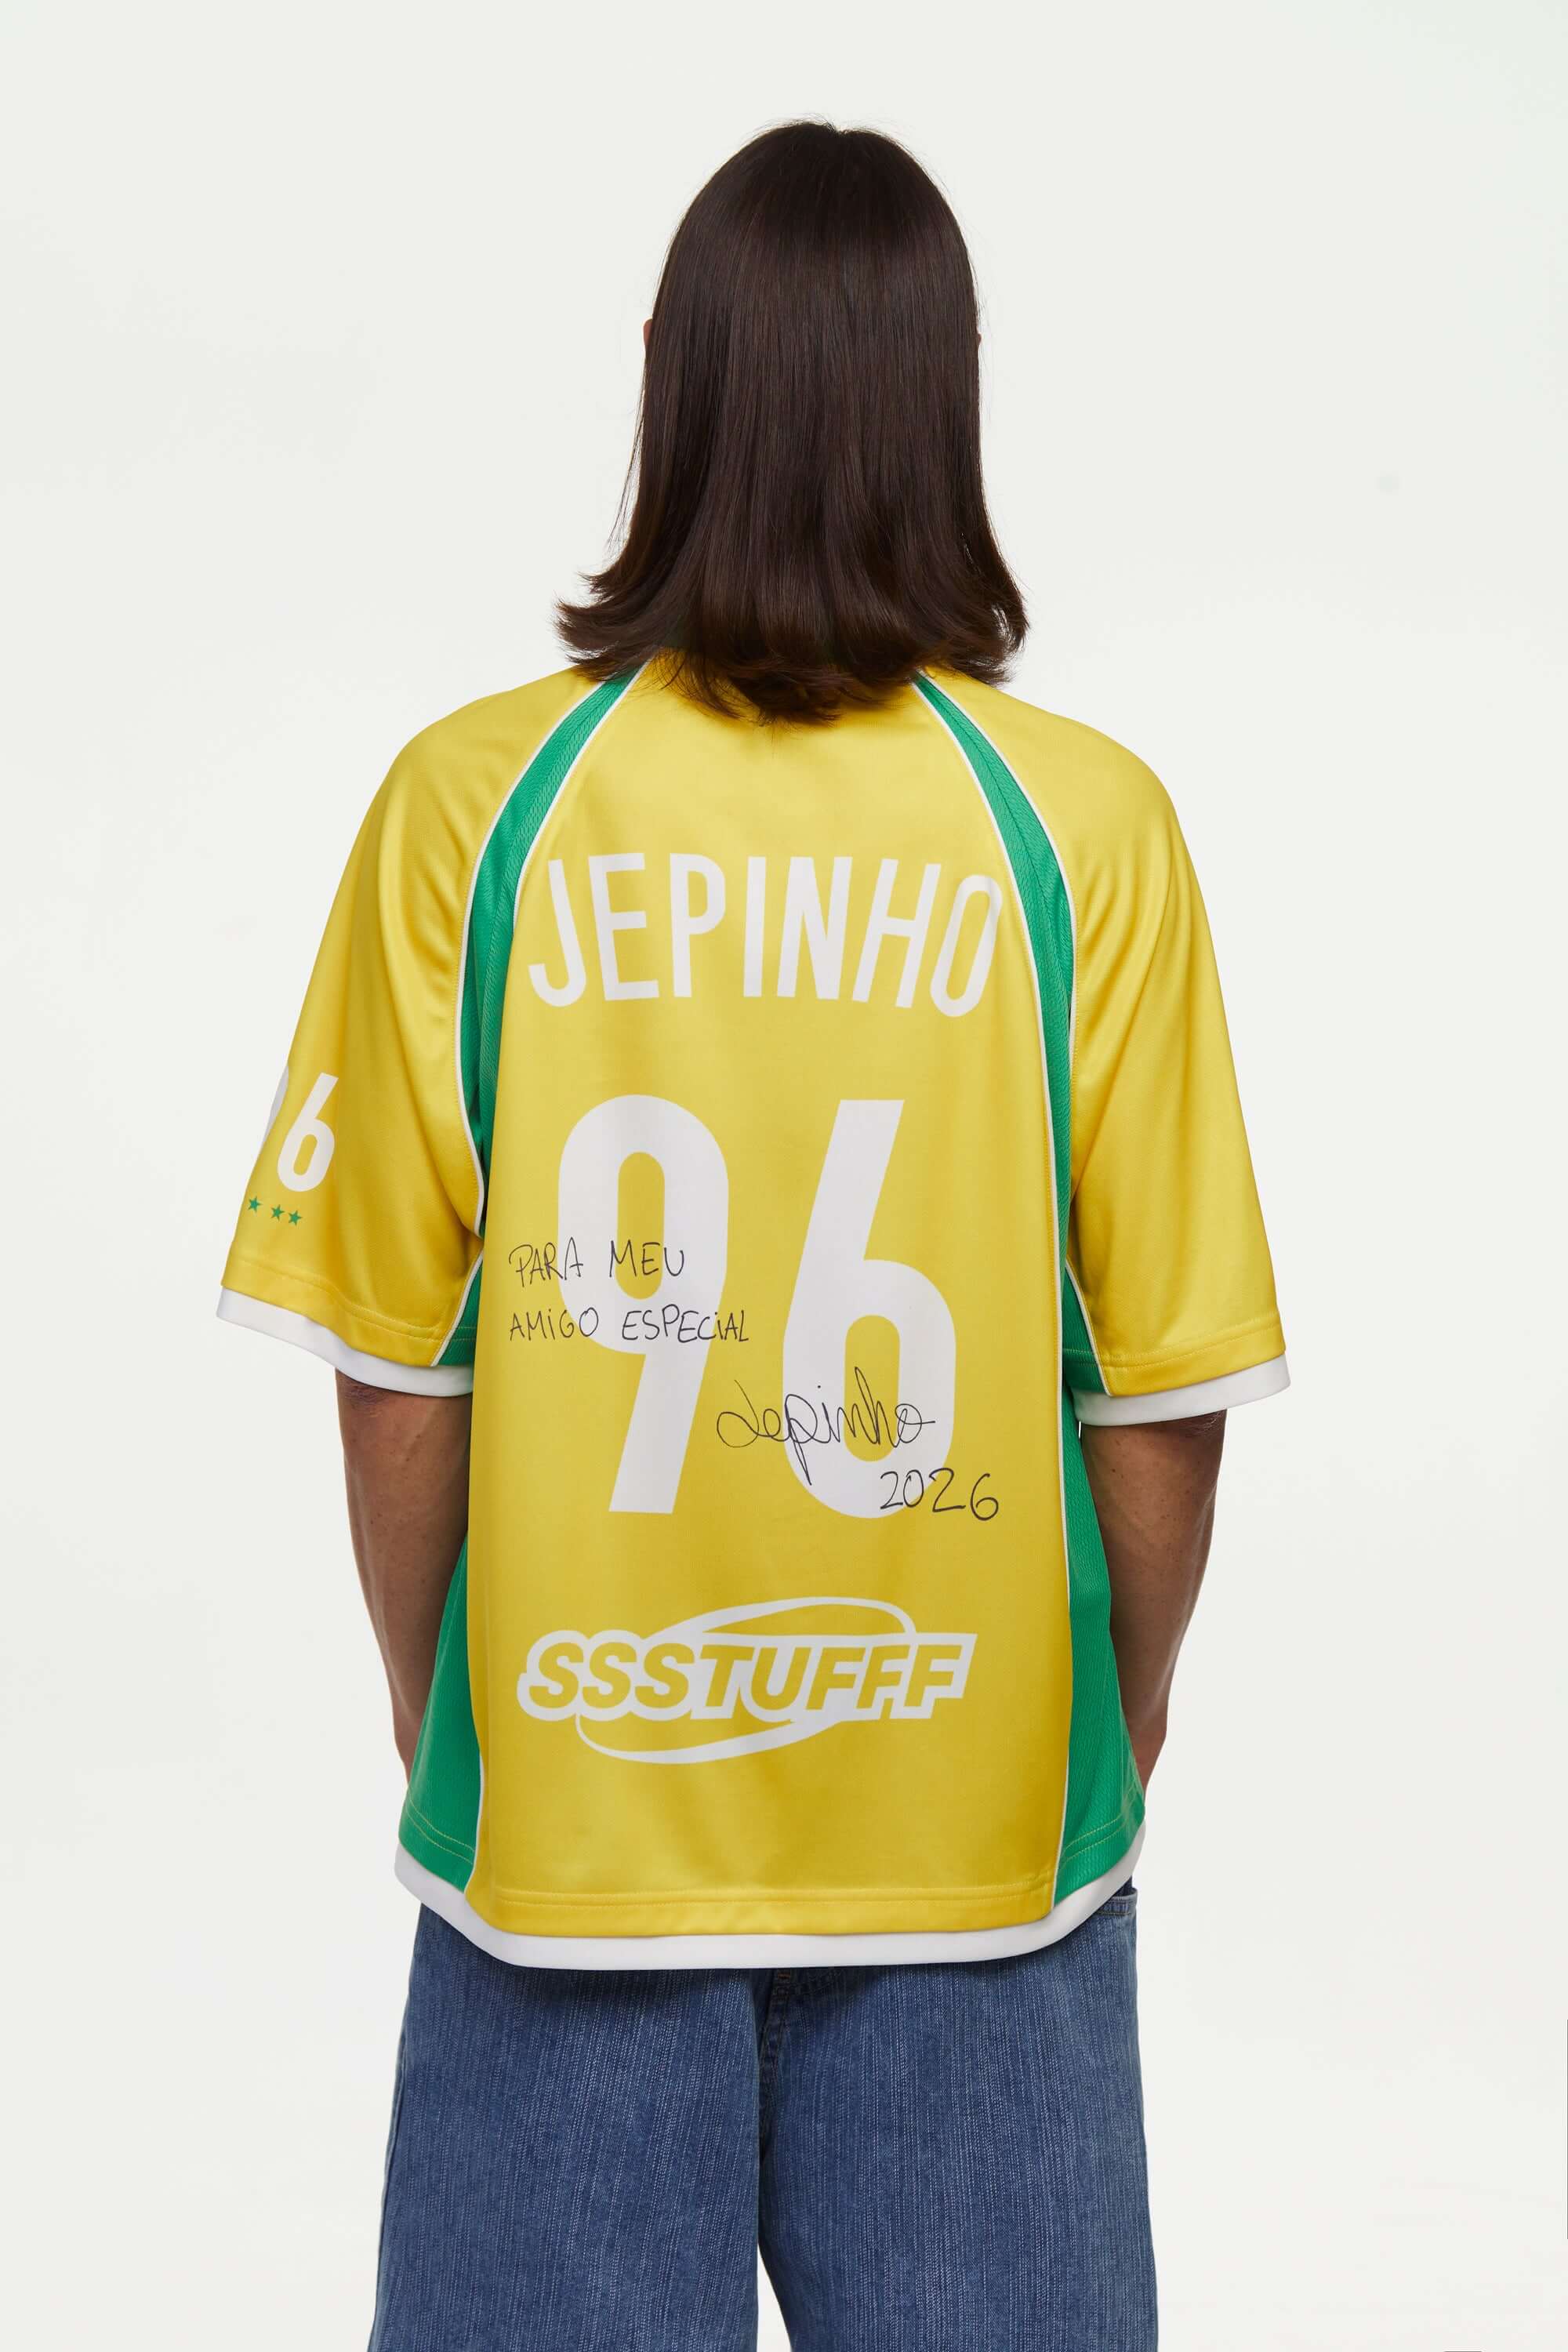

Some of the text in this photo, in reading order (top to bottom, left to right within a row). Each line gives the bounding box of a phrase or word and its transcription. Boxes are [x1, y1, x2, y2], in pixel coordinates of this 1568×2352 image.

[528, 852, 1003, 1018] JEPINHO
[262, 1063, 339, 1192] 6
[509, 1236, 684, 1287] PARA MEU
[557, 1094, 956, 1519] 96
[880, 1467, 999, 1521] 2026
[526, 1639, 967, 1713] SSSTUFFF
